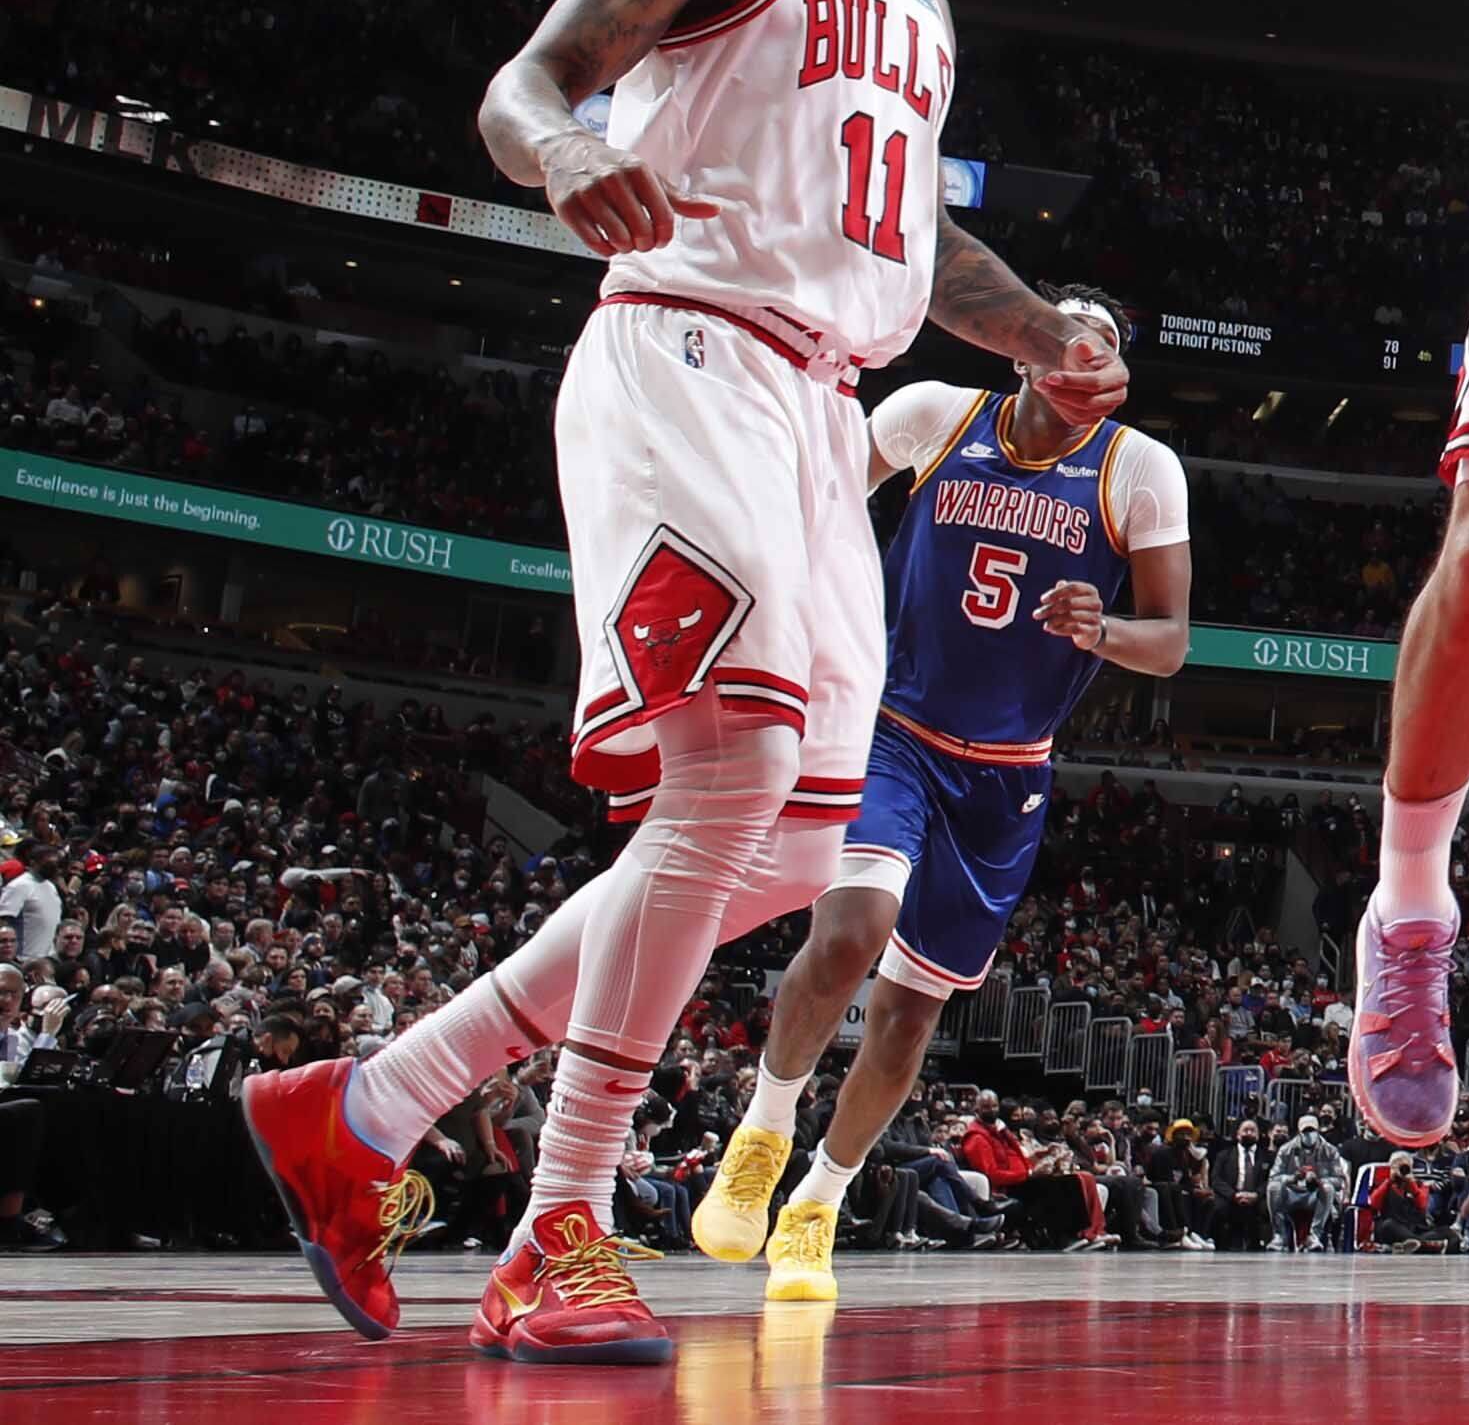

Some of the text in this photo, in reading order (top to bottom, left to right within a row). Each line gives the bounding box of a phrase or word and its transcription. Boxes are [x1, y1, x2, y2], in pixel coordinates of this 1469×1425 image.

[842, 111, 907, 266] 11
[1161, 315, 1272, 341] TORONTO RAPTORS
[1160, 331, 1261, 356] DETROIT PISTONS
[1384, 340, 1399, 354] 78
[1383, 356, 1396, 370] 91
[1056, 463, 1099, 478] Rakuten
[934, 479, 1089, 555] WARRIORS
[361, 523, 453, 569] RUSH
[961, 543, 1028, 629] 5
[1284, 641, 1369, 673] RUSH
